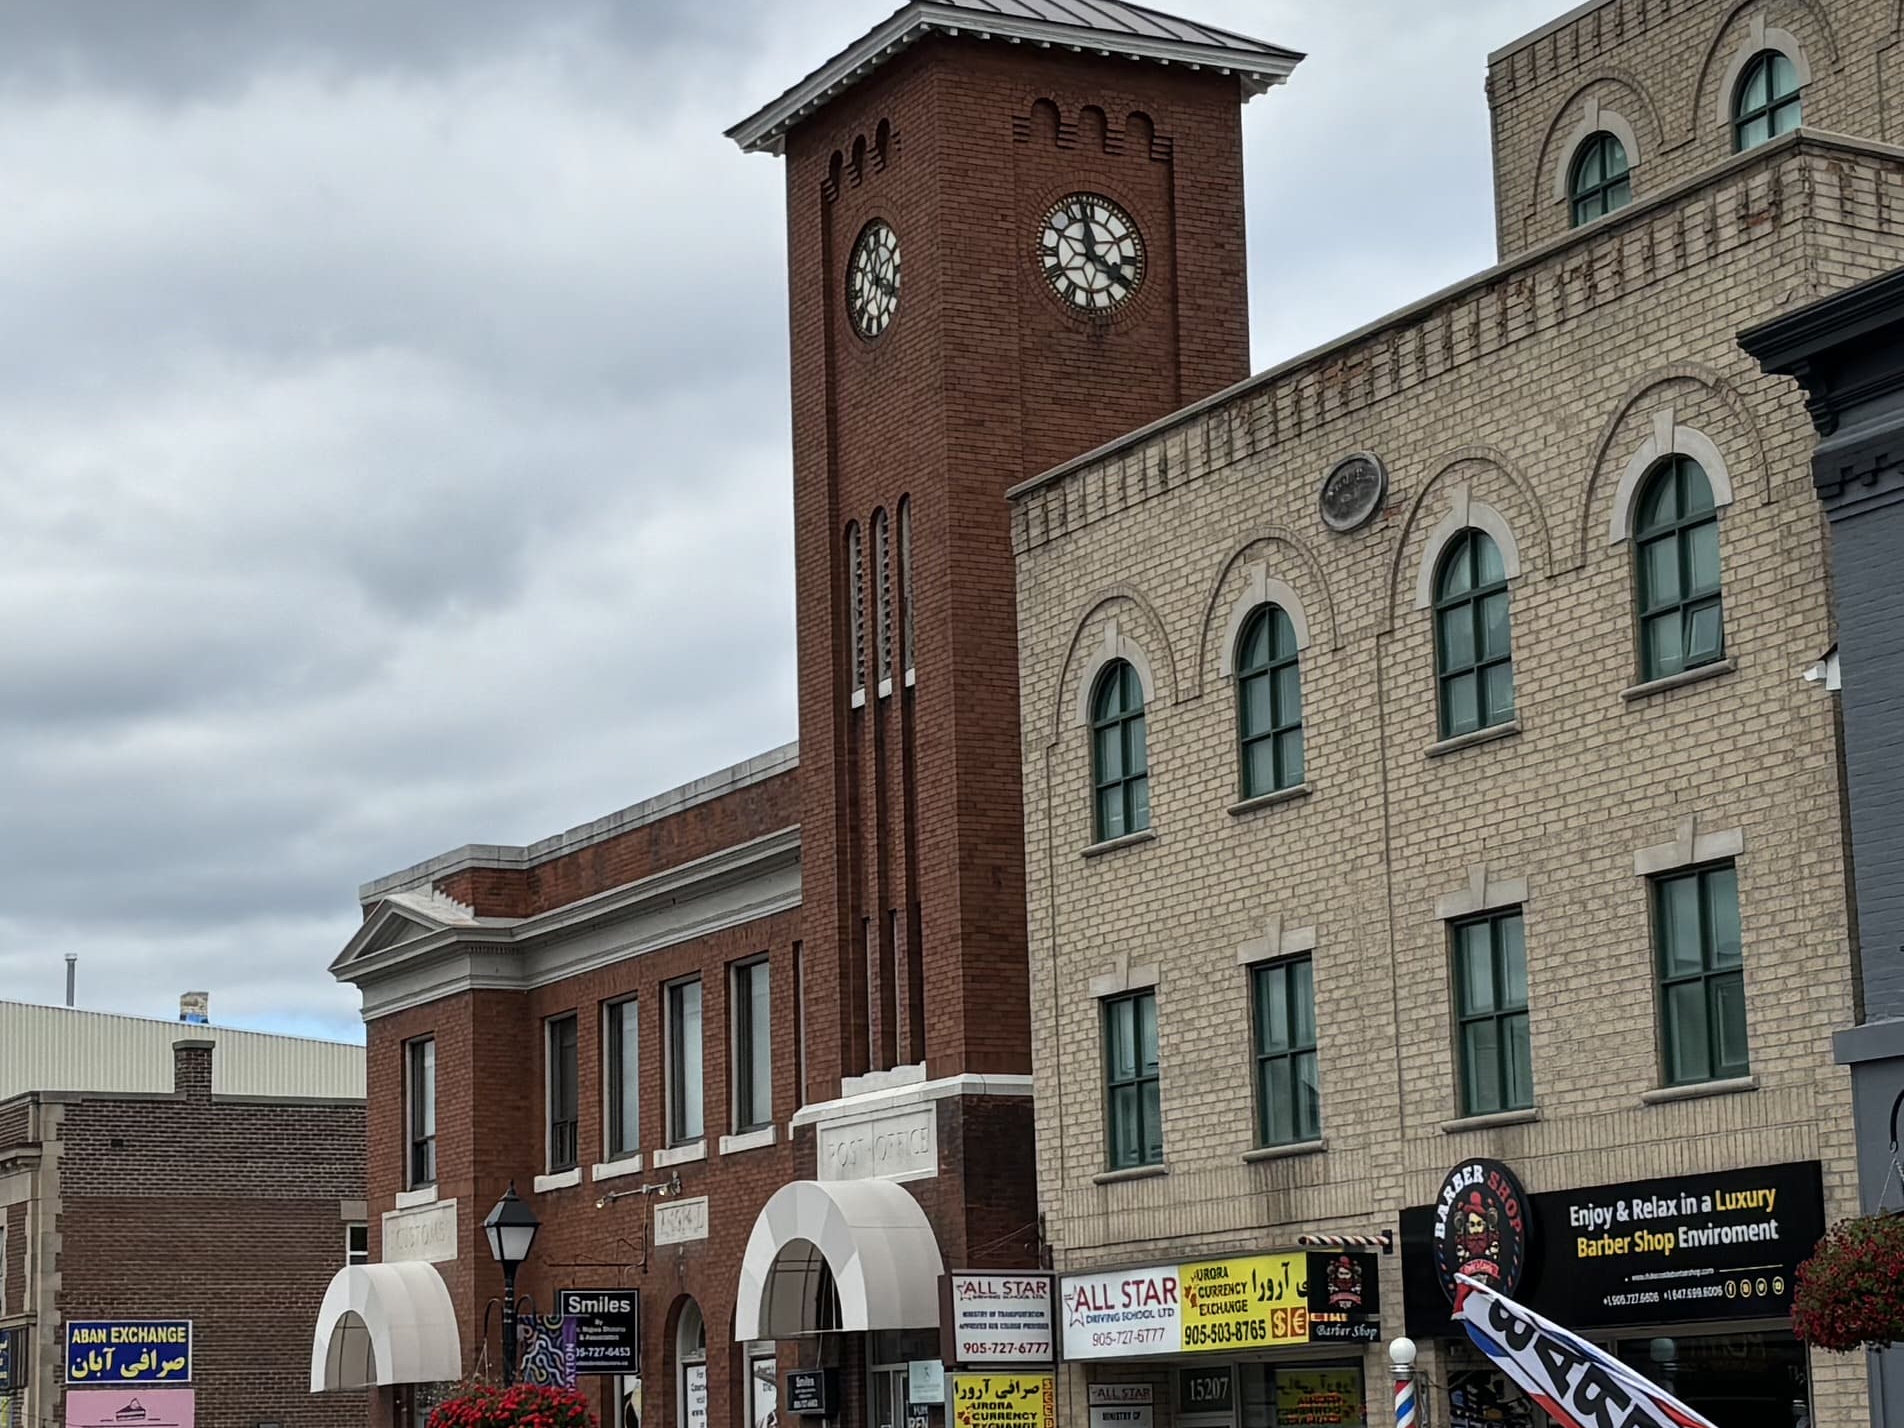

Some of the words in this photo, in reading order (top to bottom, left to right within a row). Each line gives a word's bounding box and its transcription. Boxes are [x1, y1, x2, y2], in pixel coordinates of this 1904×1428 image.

[1434, 1164, 1485, 1240] BARBER
[1487, 1170, 1523, 1234] SHOP
[1569, 1203, 1613, 1231] Enjoy
[1616, 1200, 1630, 1222] &
[1632, 1196, 1678, 1220] Relax
[1680, 1192, 1697, 1215] in
[1701, 1194, 1712, 1213] a
[1715, 1188, 1776, 1213] Luxury
[1577, 1233, 1631, 1258] Barber
[1634, 1229, 1675, 1256] Shop
[1678, 1219, 1780, 1249] Enviroment
[964, 1280, 997, 1294] ALL
[1002, 1280, 1047, 1295] STAR
[1198, 1282, 1248, 1299] CURRENCY
[1251, 1261, 1291, 1302] آرورا
[568, 1295, 631, 1313] Smiles
[1074, 1283, 1116, 1313] ALL
[1121, 1276, 1178, 1309] STAR
[1085, 1313, 1121, 1325] DRIVING
[1121, 1310, 1156, 1322] SCHOOL
[1157, 1307, 1175, 1319] LTD
[1199, 1299, 1248, 1316] EXCHANGE
[71, 1328, 107, 1344] ABAN
[110, 1327, 187, 1343] EXCHANGE
[1092, 1327, 1165, 1347] 905-727-6777
[1184, 1319, 1267, 1346] 905-503-8765
[1316, 1324, 1351, 1337] Barber
[1353, 1323, 1378, 1339] Shop
[963, 1341, 1050, 1355] 905-727-6777
[71, 1346, 116, 1379] آبان
[120, 1347, 186, 1378] صرافی
[954, 1377, 992, 1400] آرورا
[994, 1378, 1041, 1400] صرافی
[1190, 1377, 1229, 1401] 15207
[971, 1411, 1038, 1421] CURRENCY
